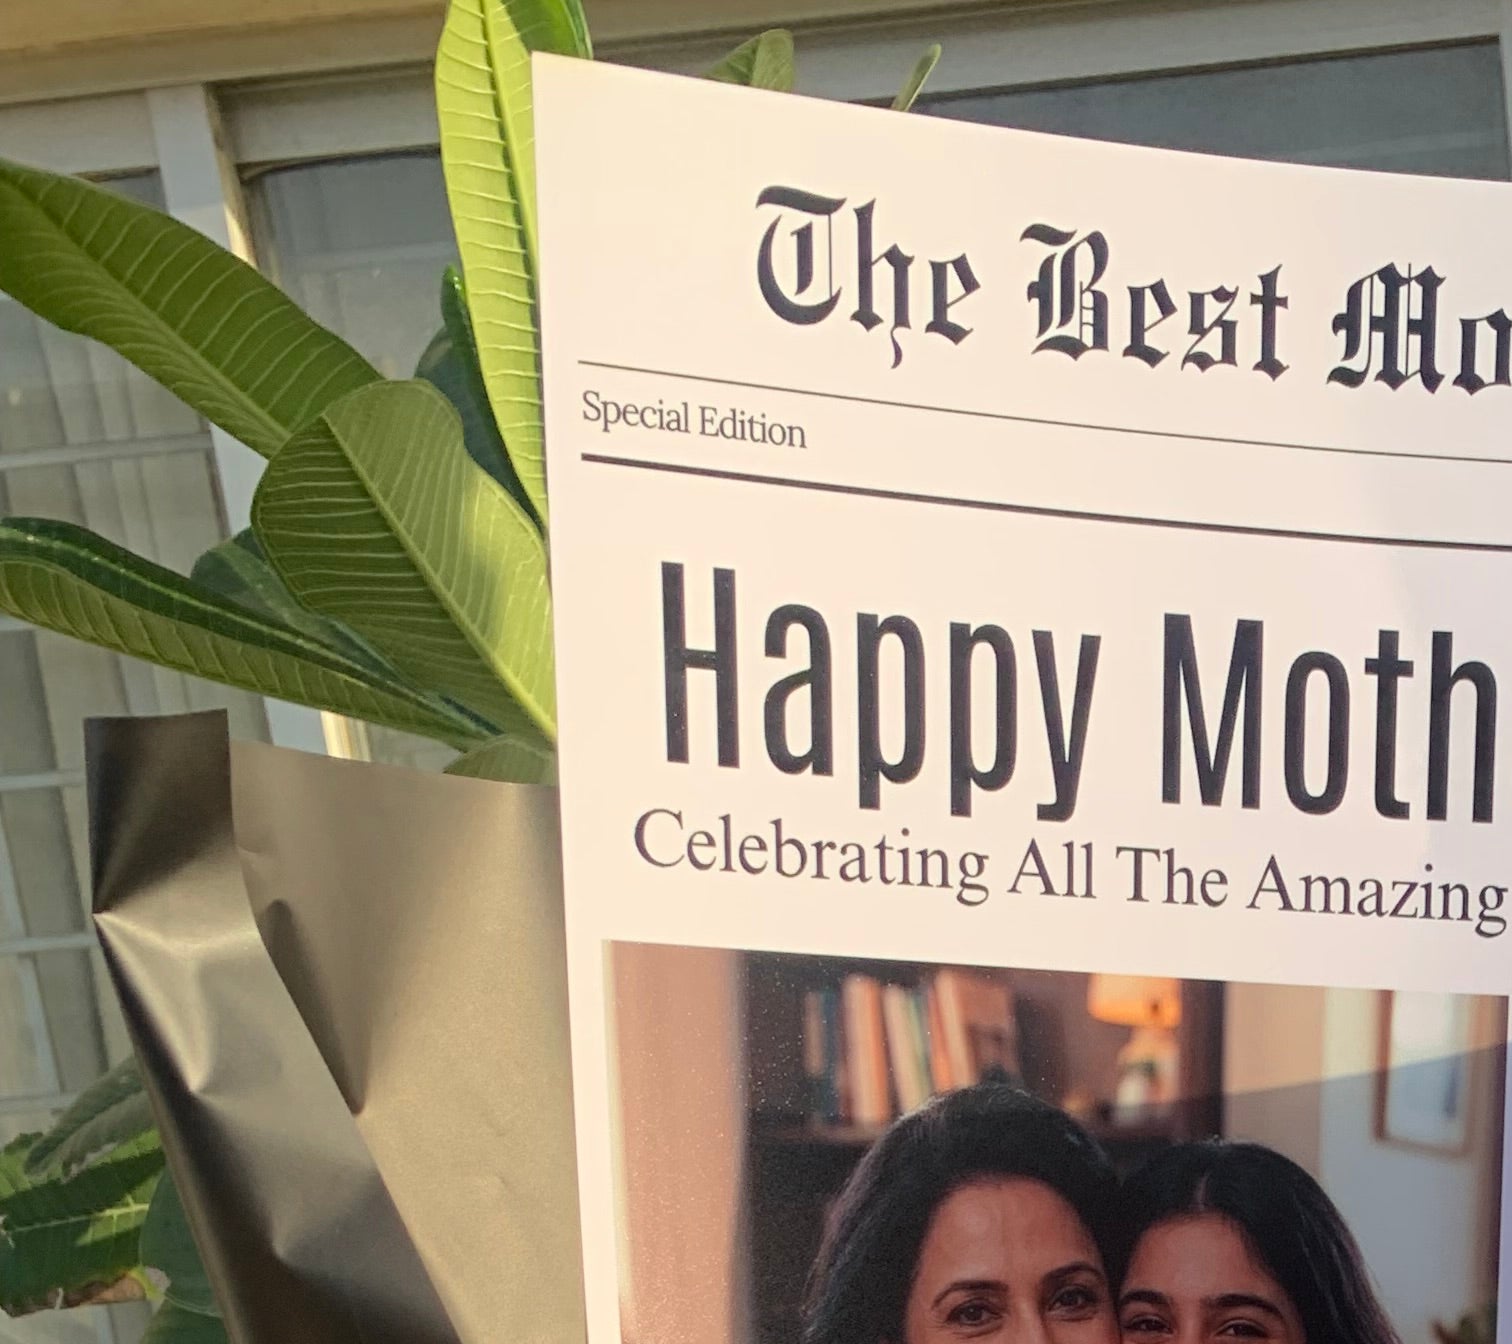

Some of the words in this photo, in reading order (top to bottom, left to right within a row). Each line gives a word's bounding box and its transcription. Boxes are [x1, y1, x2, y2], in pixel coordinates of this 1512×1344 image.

[756, 186, 980, 369] The
[1020, 224, 1289, 381] Best
[583, 390, 690, 433] Special
[699, 406, 807, 448] Edition
[660, 561, 1101, 823] Happy
[634, 809, 989, 906] Celebrating
[1007, 838, 1096, 898] All
[1116, 846, 1228, 907] The
[1246, 855, 1508, 938] Amazing
